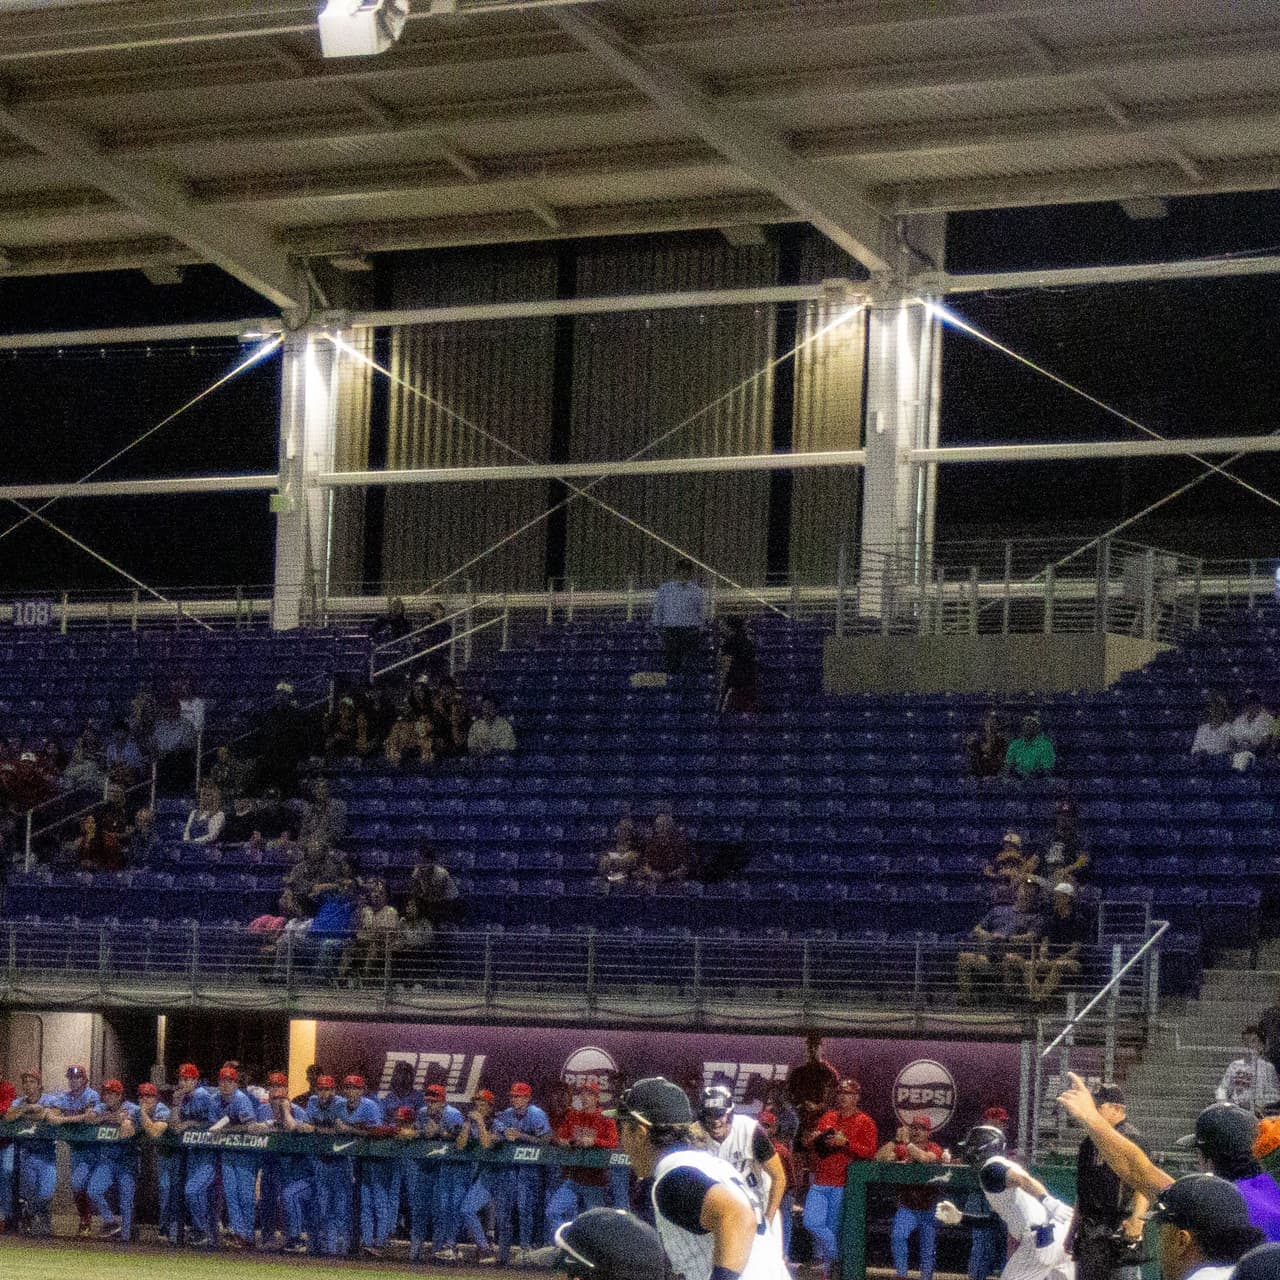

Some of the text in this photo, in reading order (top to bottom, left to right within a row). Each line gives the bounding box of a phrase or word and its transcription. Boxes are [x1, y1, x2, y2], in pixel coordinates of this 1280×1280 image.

[13, 602, 49, 626] 108
[897, 1087, 953, 1107] PEPSI
[513, 1147, 541, 1161] GCU
